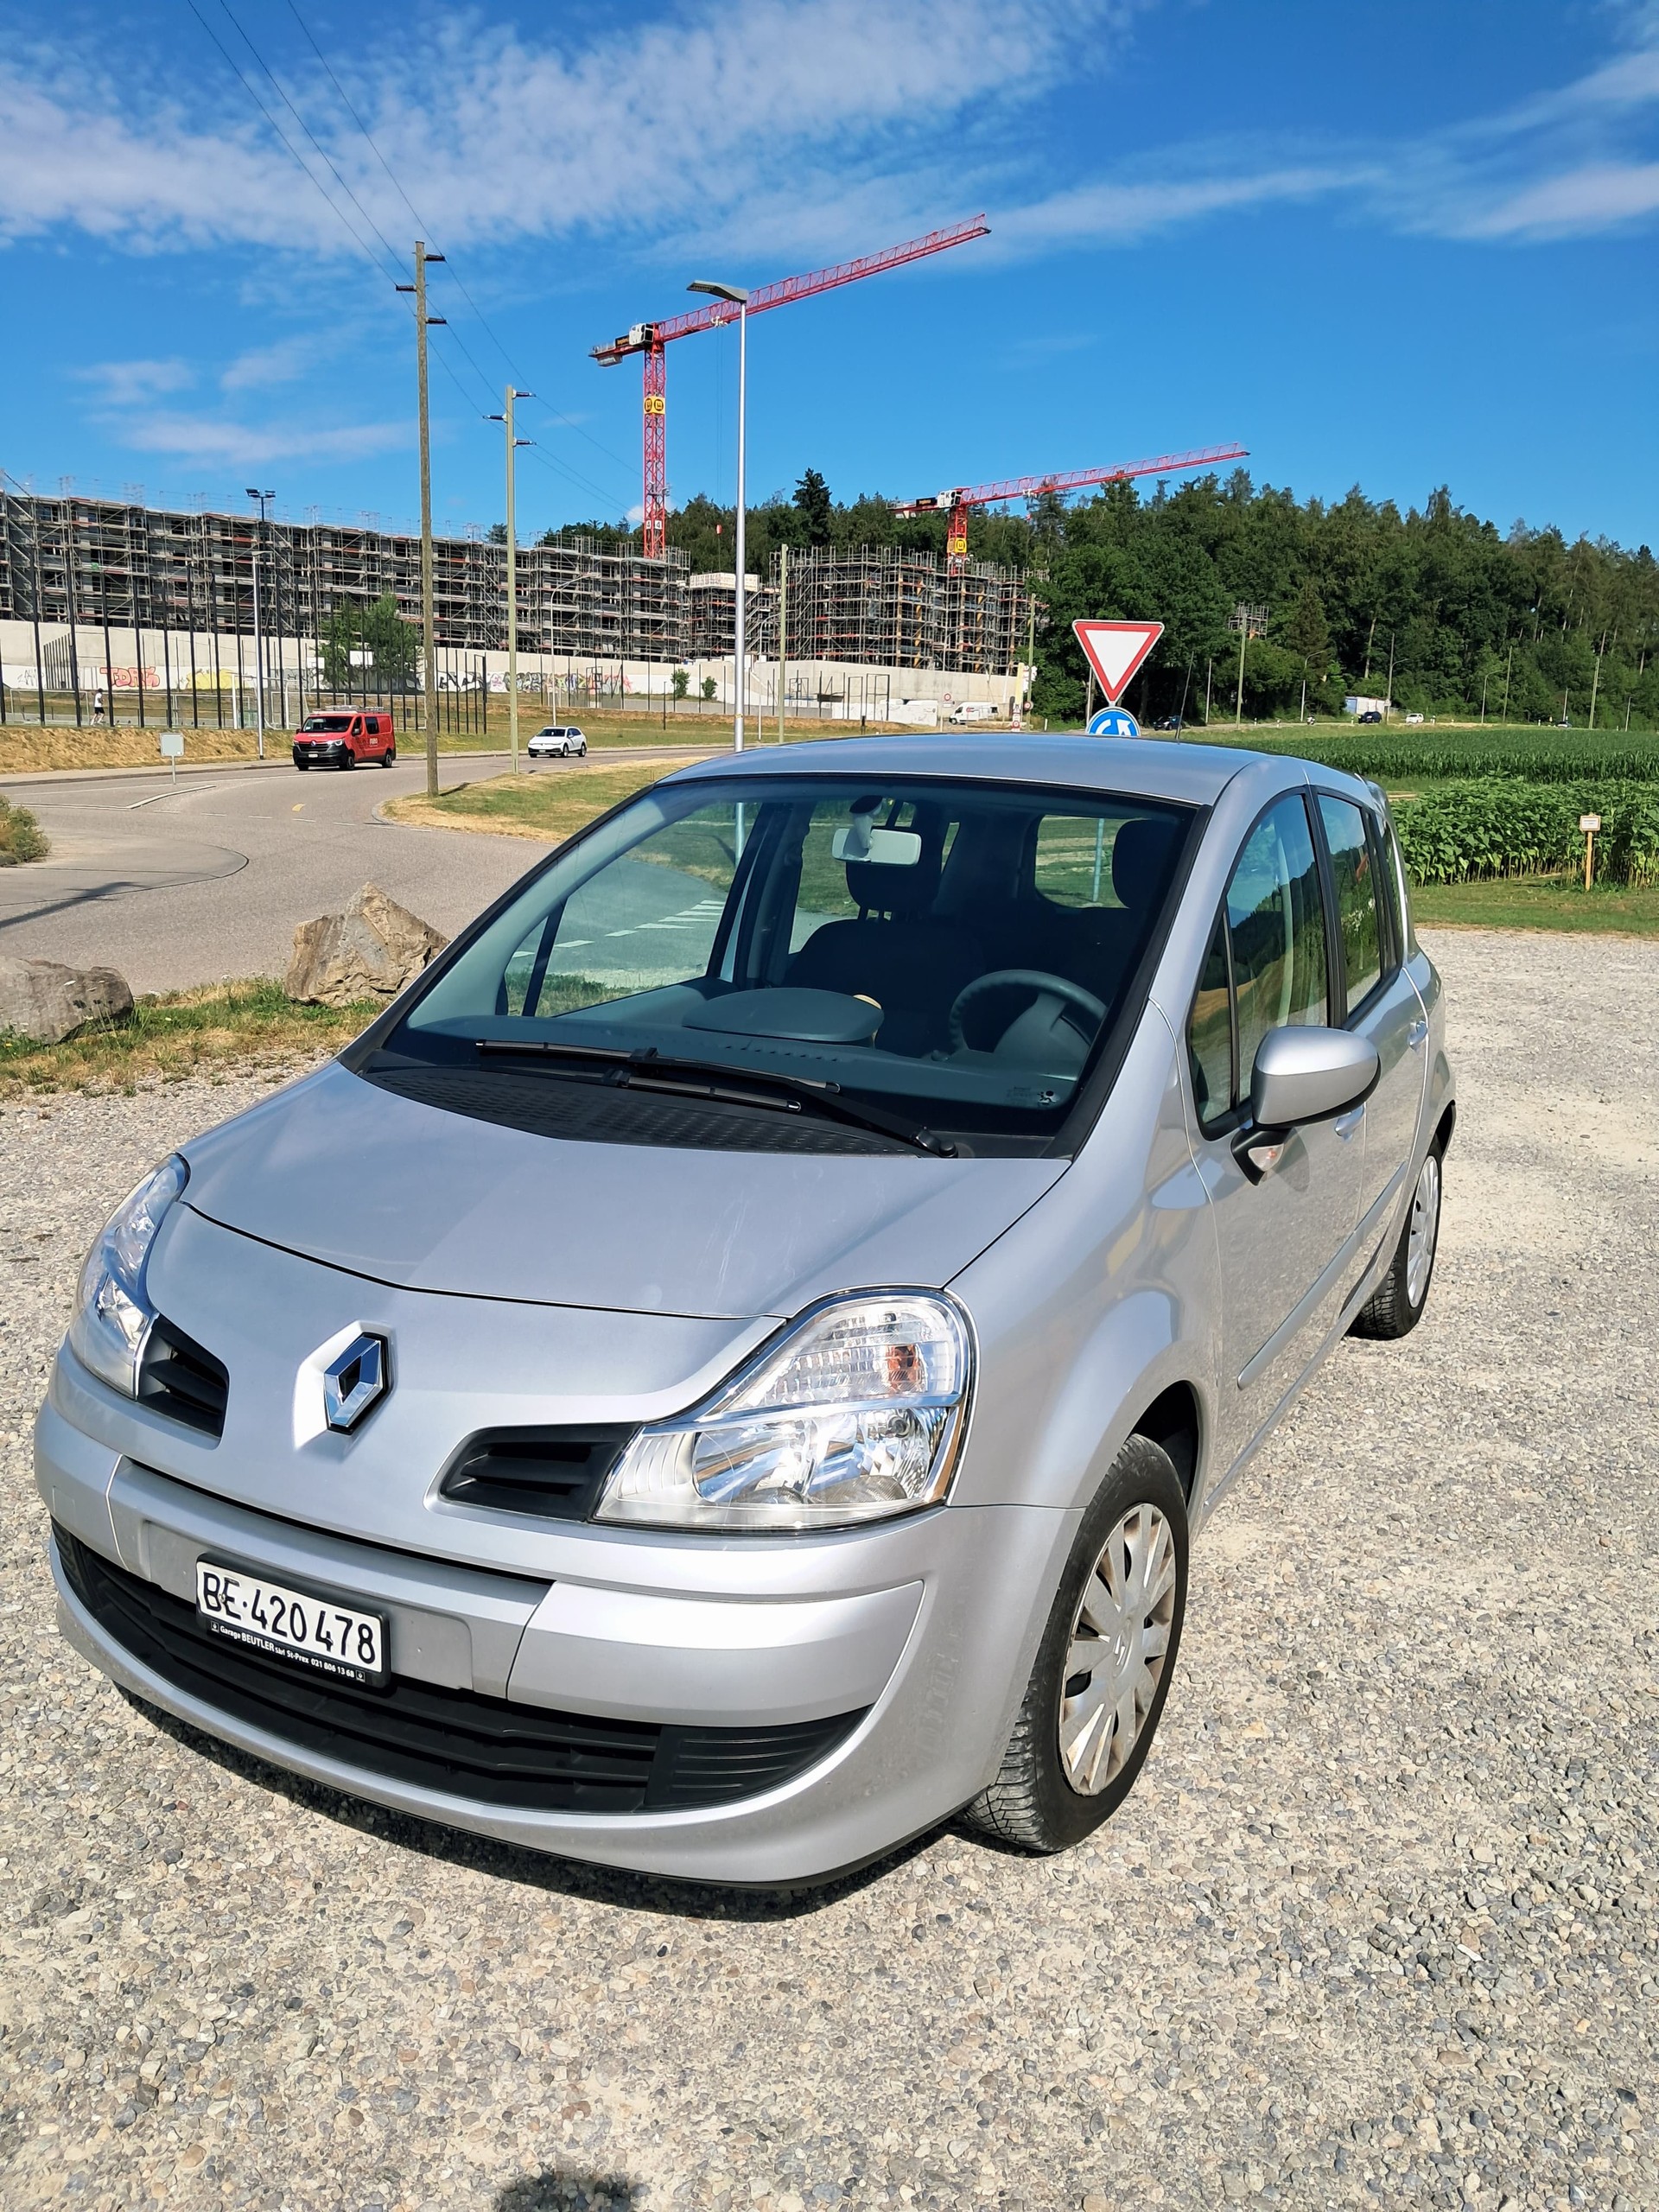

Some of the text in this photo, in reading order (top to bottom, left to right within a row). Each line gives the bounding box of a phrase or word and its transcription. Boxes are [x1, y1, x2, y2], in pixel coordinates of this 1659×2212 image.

[219, 1625, 241, 1639] Garage
[242, 1632, 275, 1652] BEUTLER
[287, 1650, 309, 1664] St-Prex
[311, 1658, 323, 1669] 021
[337, 1666, 346, 1675] 13
